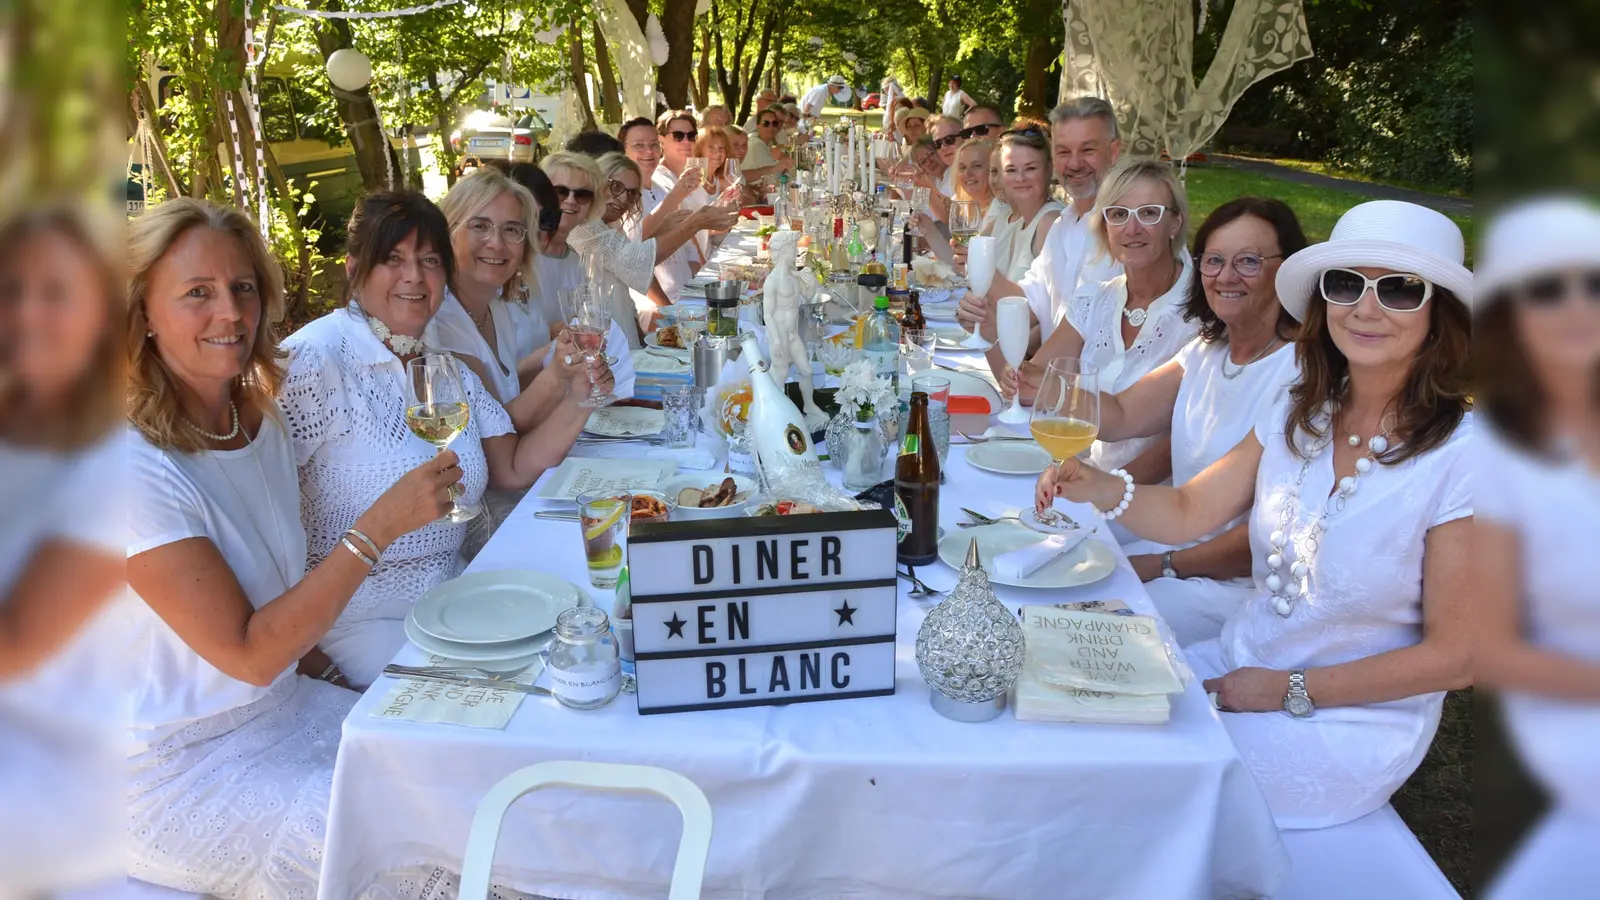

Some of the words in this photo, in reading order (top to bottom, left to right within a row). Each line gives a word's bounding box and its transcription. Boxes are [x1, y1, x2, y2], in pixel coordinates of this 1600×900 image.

[692, 536, 842, 585] DINER
[697, 601, 750, 645] EN
[1033, 615, 1151, 635] CHAMPAGNE
[1067, 633, 1124, 646] DRINK
[1076, 646, 1119, 659] AND
[705, 652, 851, 699] BLANC
[1070, 657, 1137, 674] WATER
[383, 654, 447, 717] CHPAGNE
[486, 687, 509, 704] VE
[461, 685, 489, 708] TER
